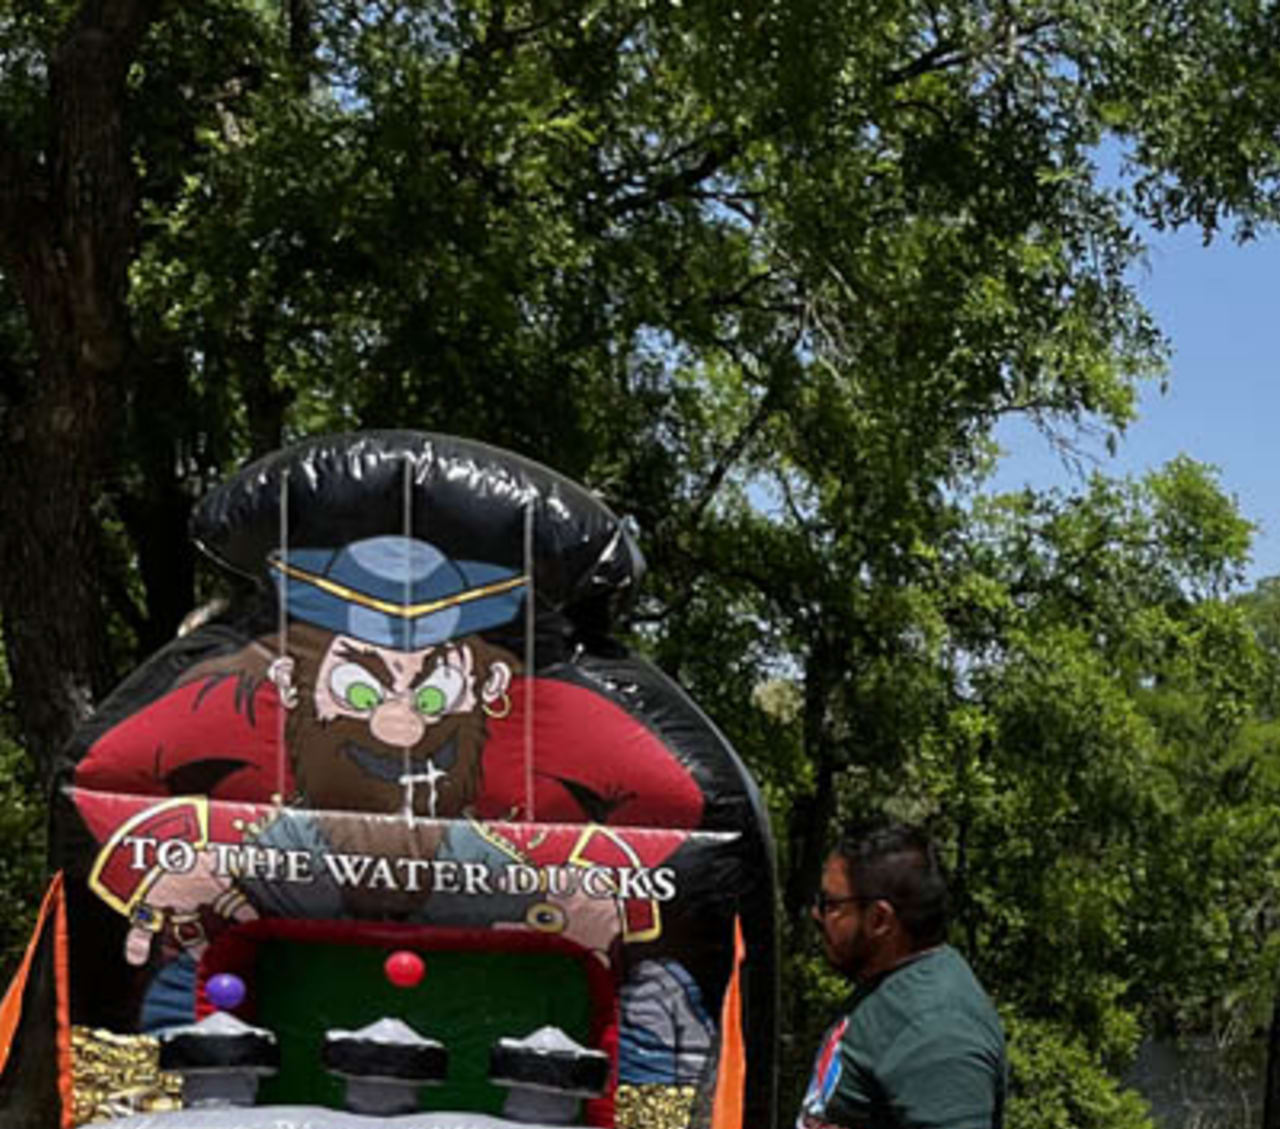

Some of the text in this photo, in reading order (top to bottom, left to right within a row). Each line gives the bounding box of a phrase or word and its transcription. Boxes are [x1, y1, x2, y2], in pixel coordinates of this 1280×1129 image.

[124, 837, 677, 901] TO THE WATER DUCKS
